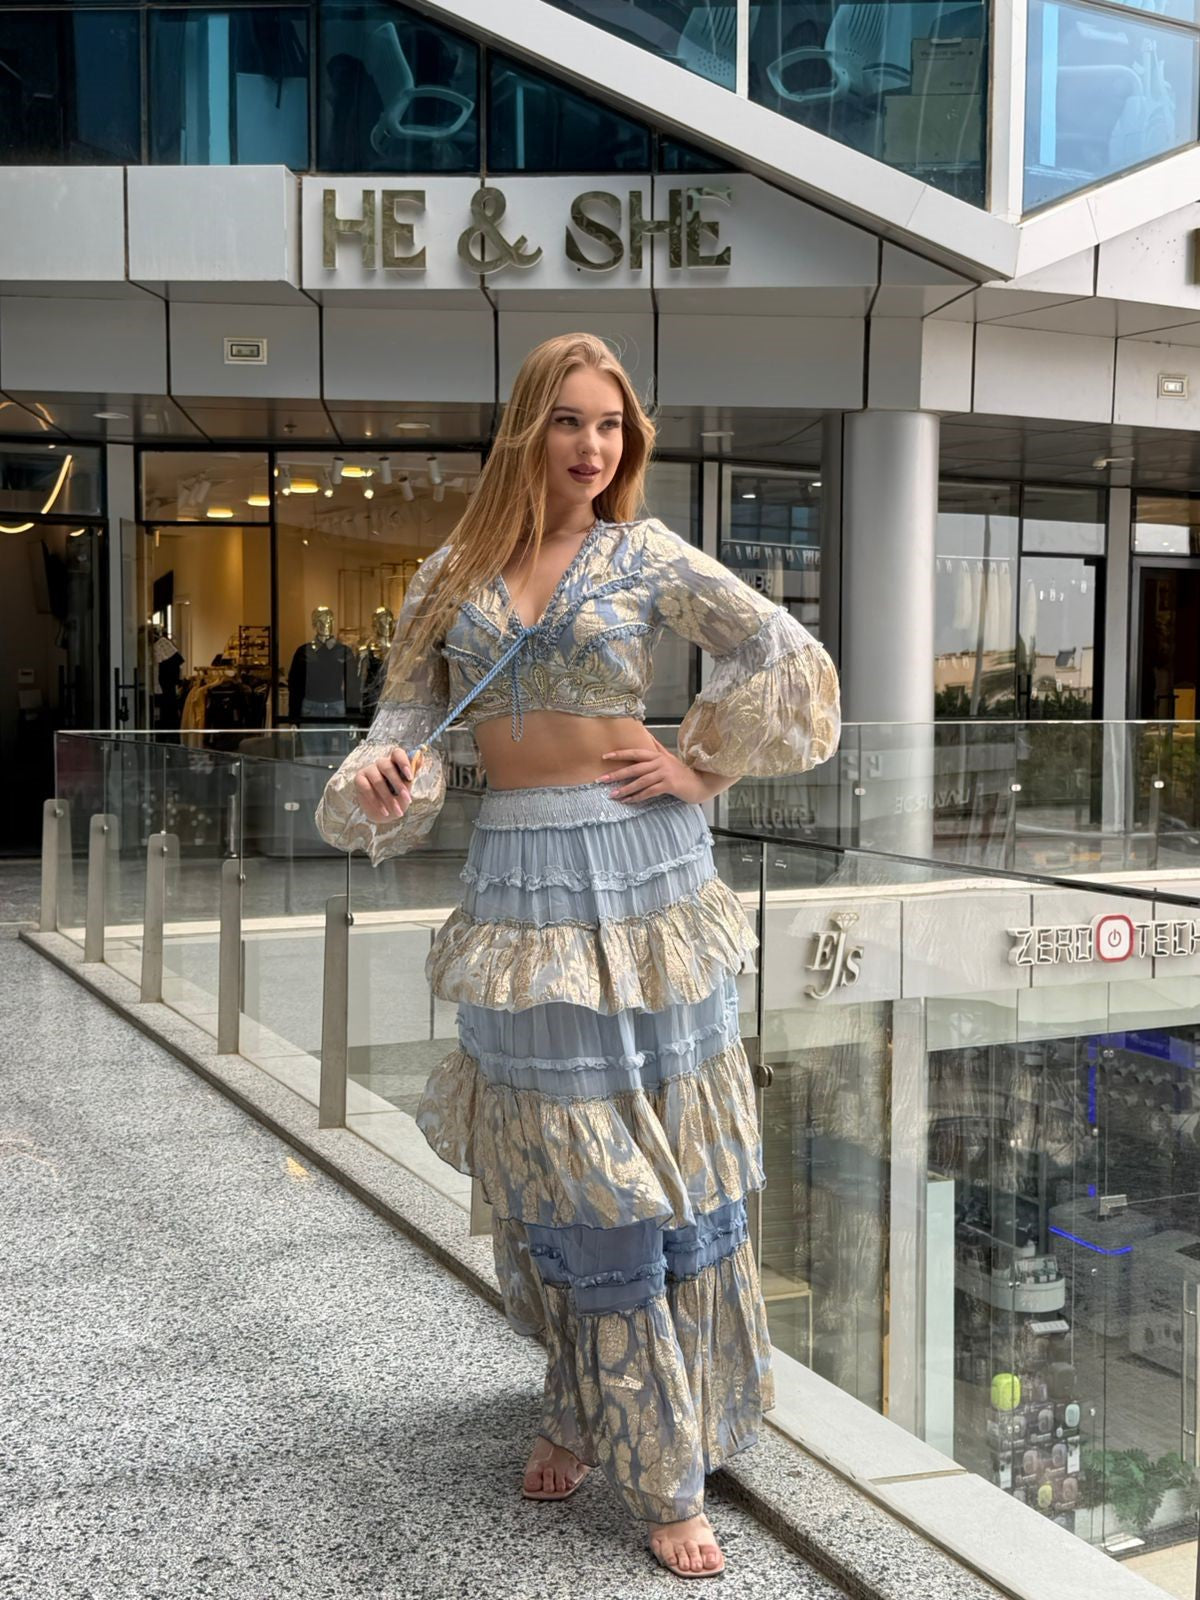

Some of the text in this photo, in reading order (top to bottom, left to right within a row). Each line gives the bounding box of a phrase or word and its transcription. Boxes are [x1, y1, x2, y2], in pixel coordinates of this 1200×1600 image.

[322, 186, 733, 275] HE & SHE
[1012, 925, 1094, 966] ZERO
